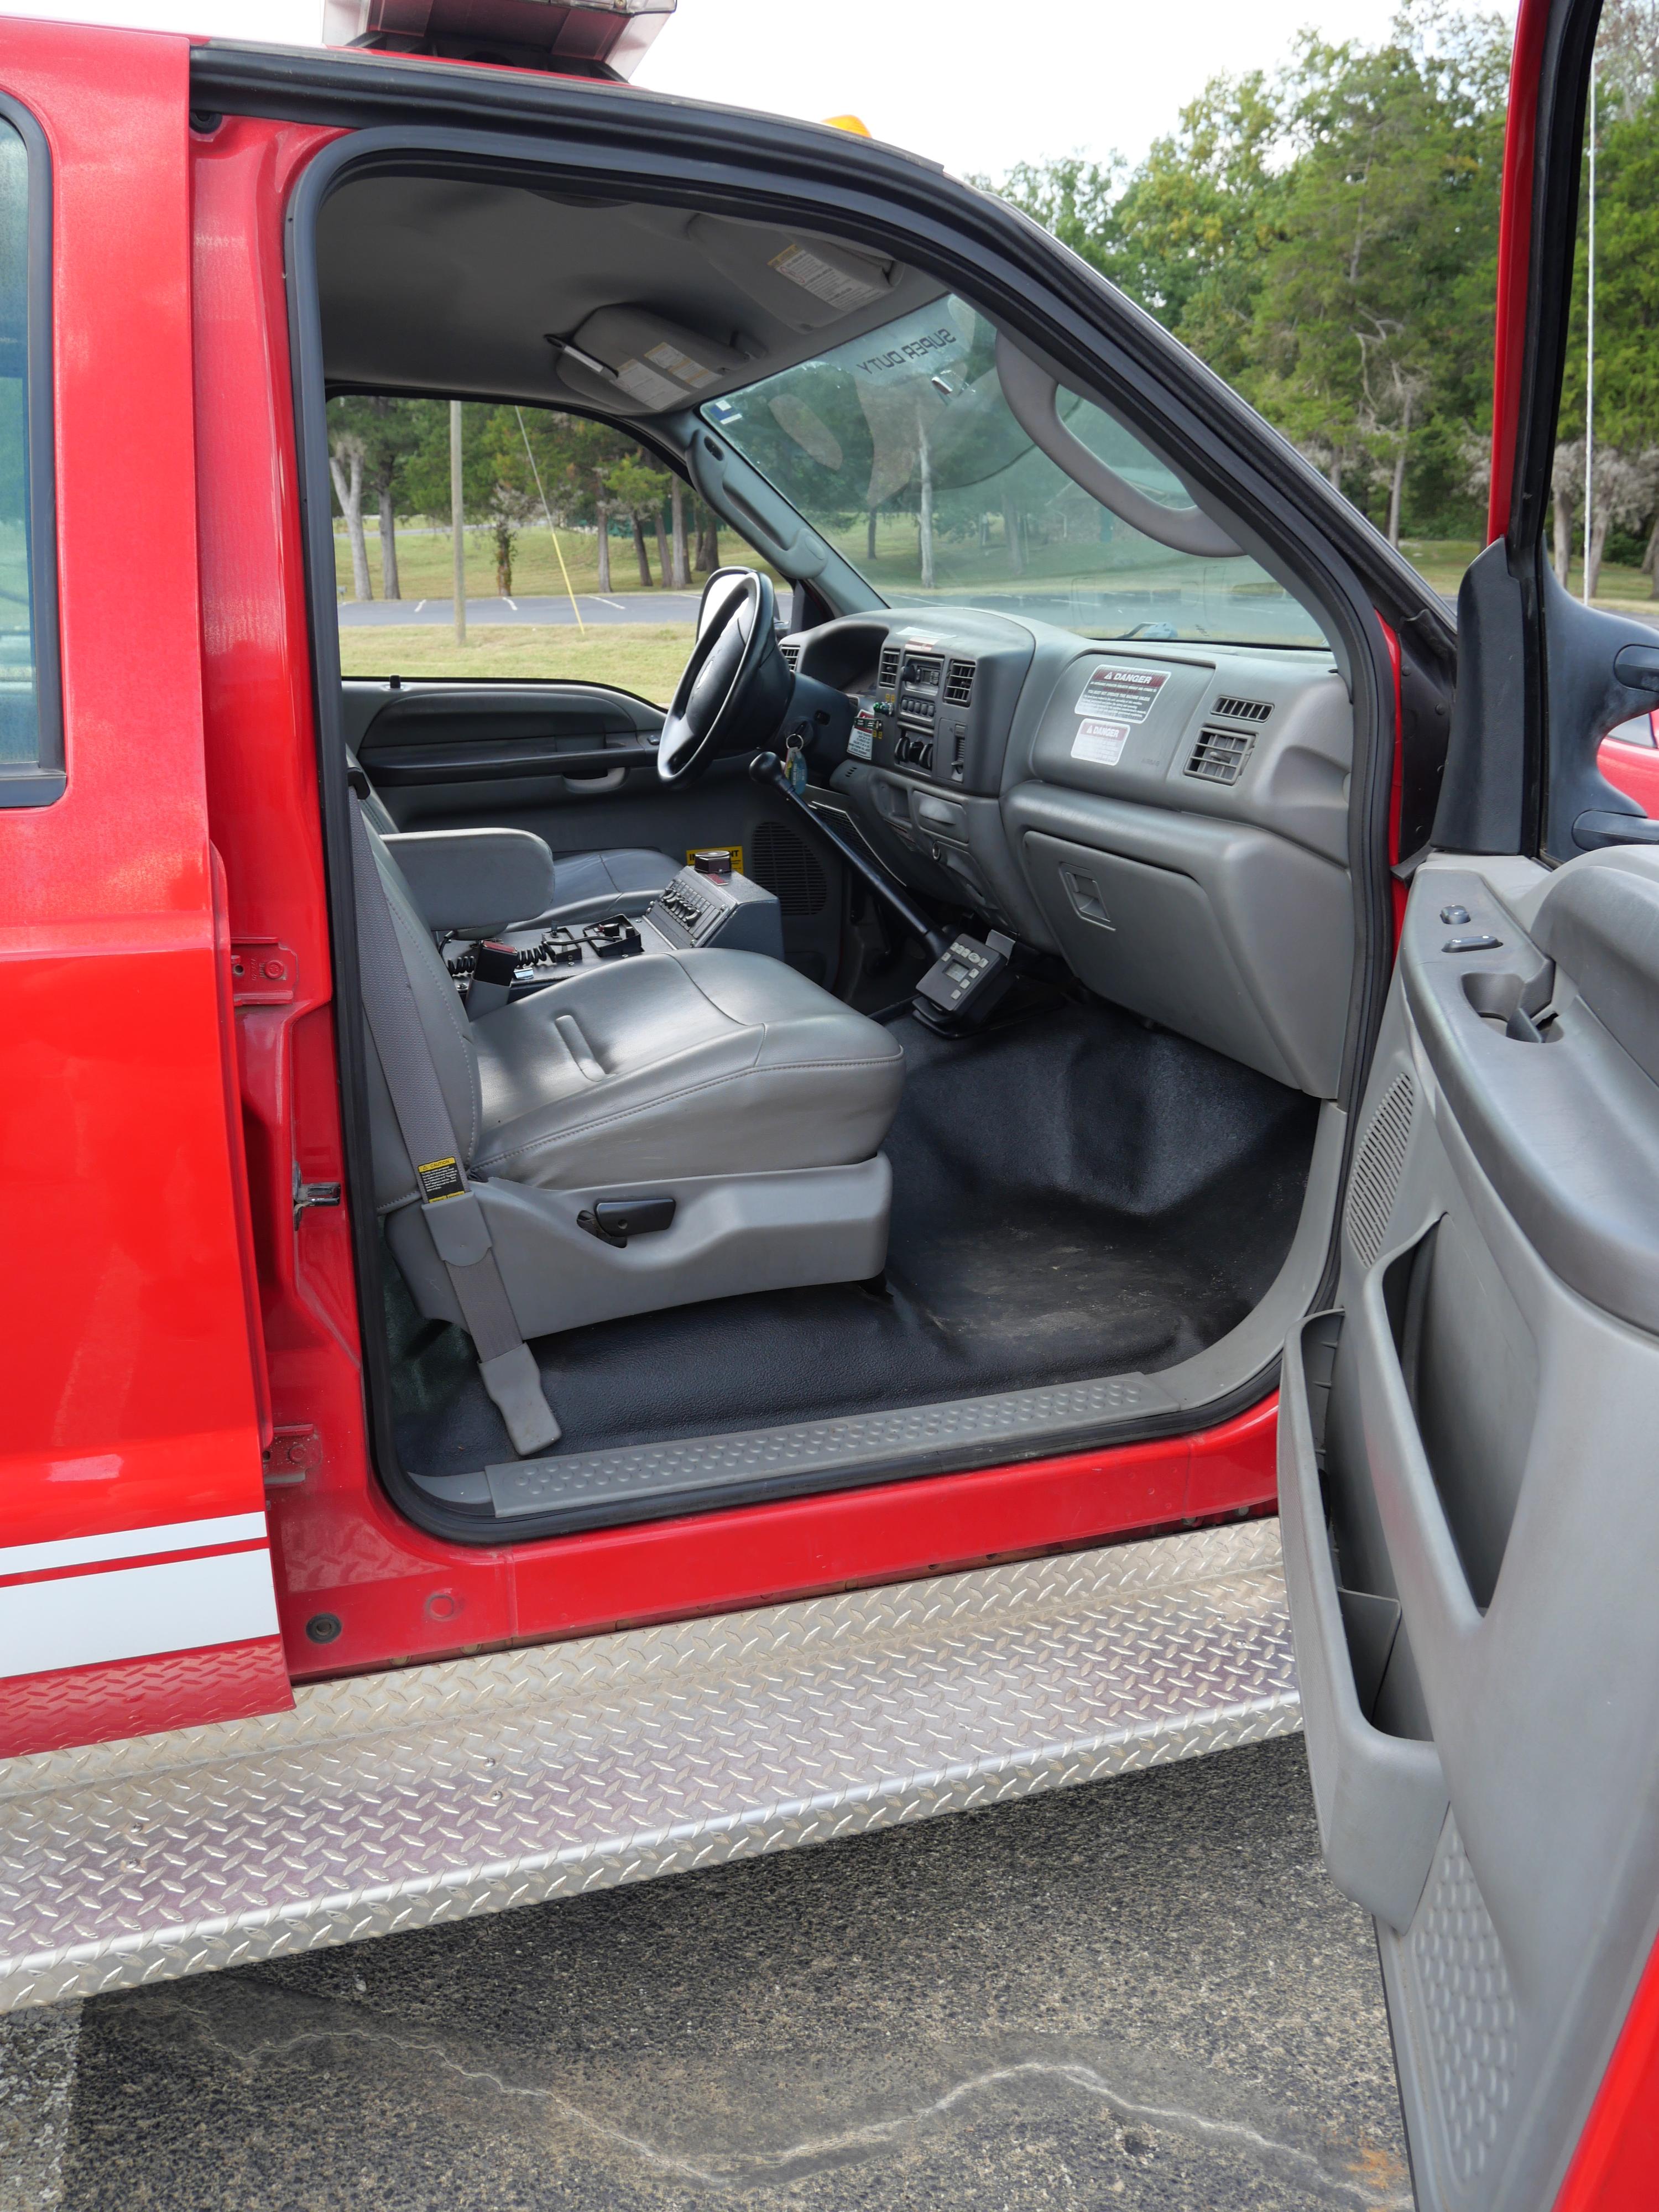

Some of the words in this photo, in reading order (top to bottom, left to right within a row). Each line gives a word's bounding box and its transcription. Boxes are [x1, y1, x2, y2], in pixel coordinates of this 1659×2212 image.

[1113, 672, 1152, 684] DANGER
[1092, 726, 1120, 738] DANGER
[430, 1160, 450, 1168] CAUTION
